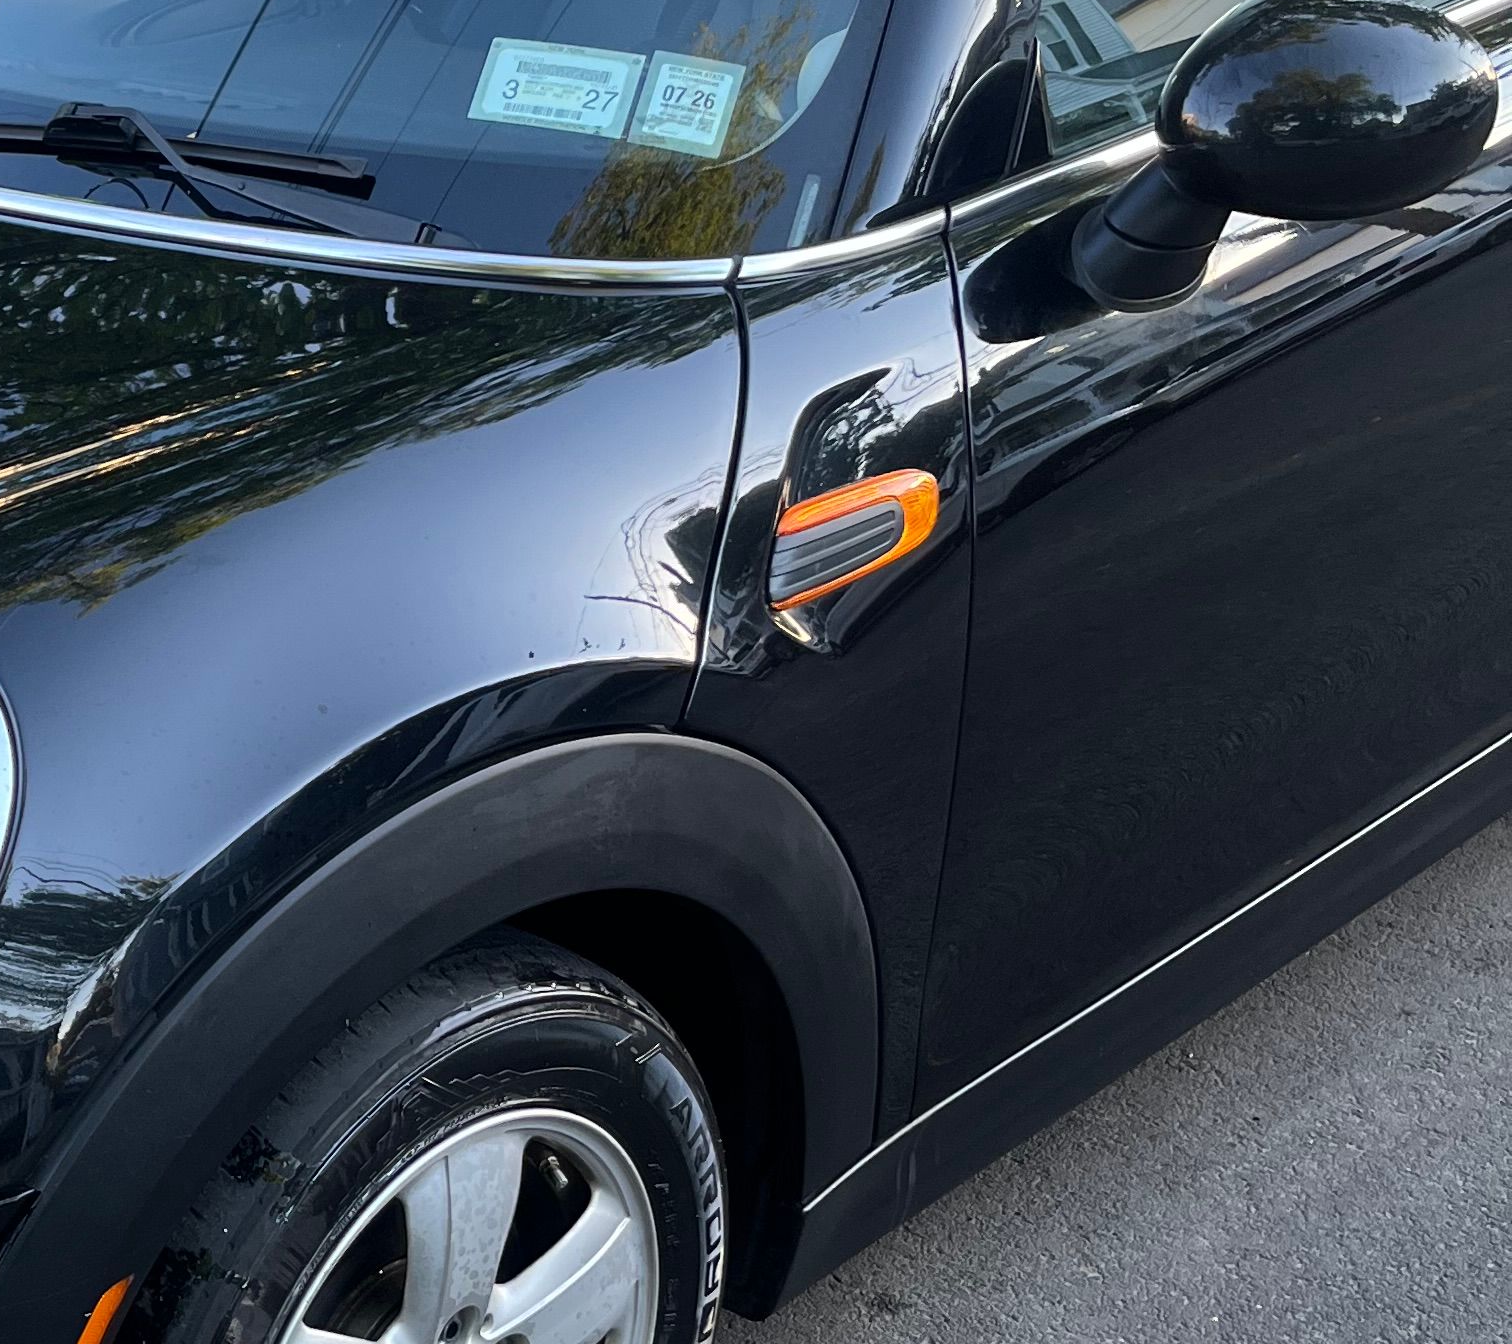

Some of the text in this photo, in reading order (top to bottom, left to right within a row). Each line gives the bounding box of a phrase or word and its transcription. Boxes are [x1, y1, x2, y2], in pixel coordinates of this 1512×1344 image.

[502, 79, 520, 100] 3
[582, 88, 620, 113] 27
[661, 84, 688, 104] 07
[691, 89, 717, 110] 26
[669, 1096, 724, 1344] ARROYO
